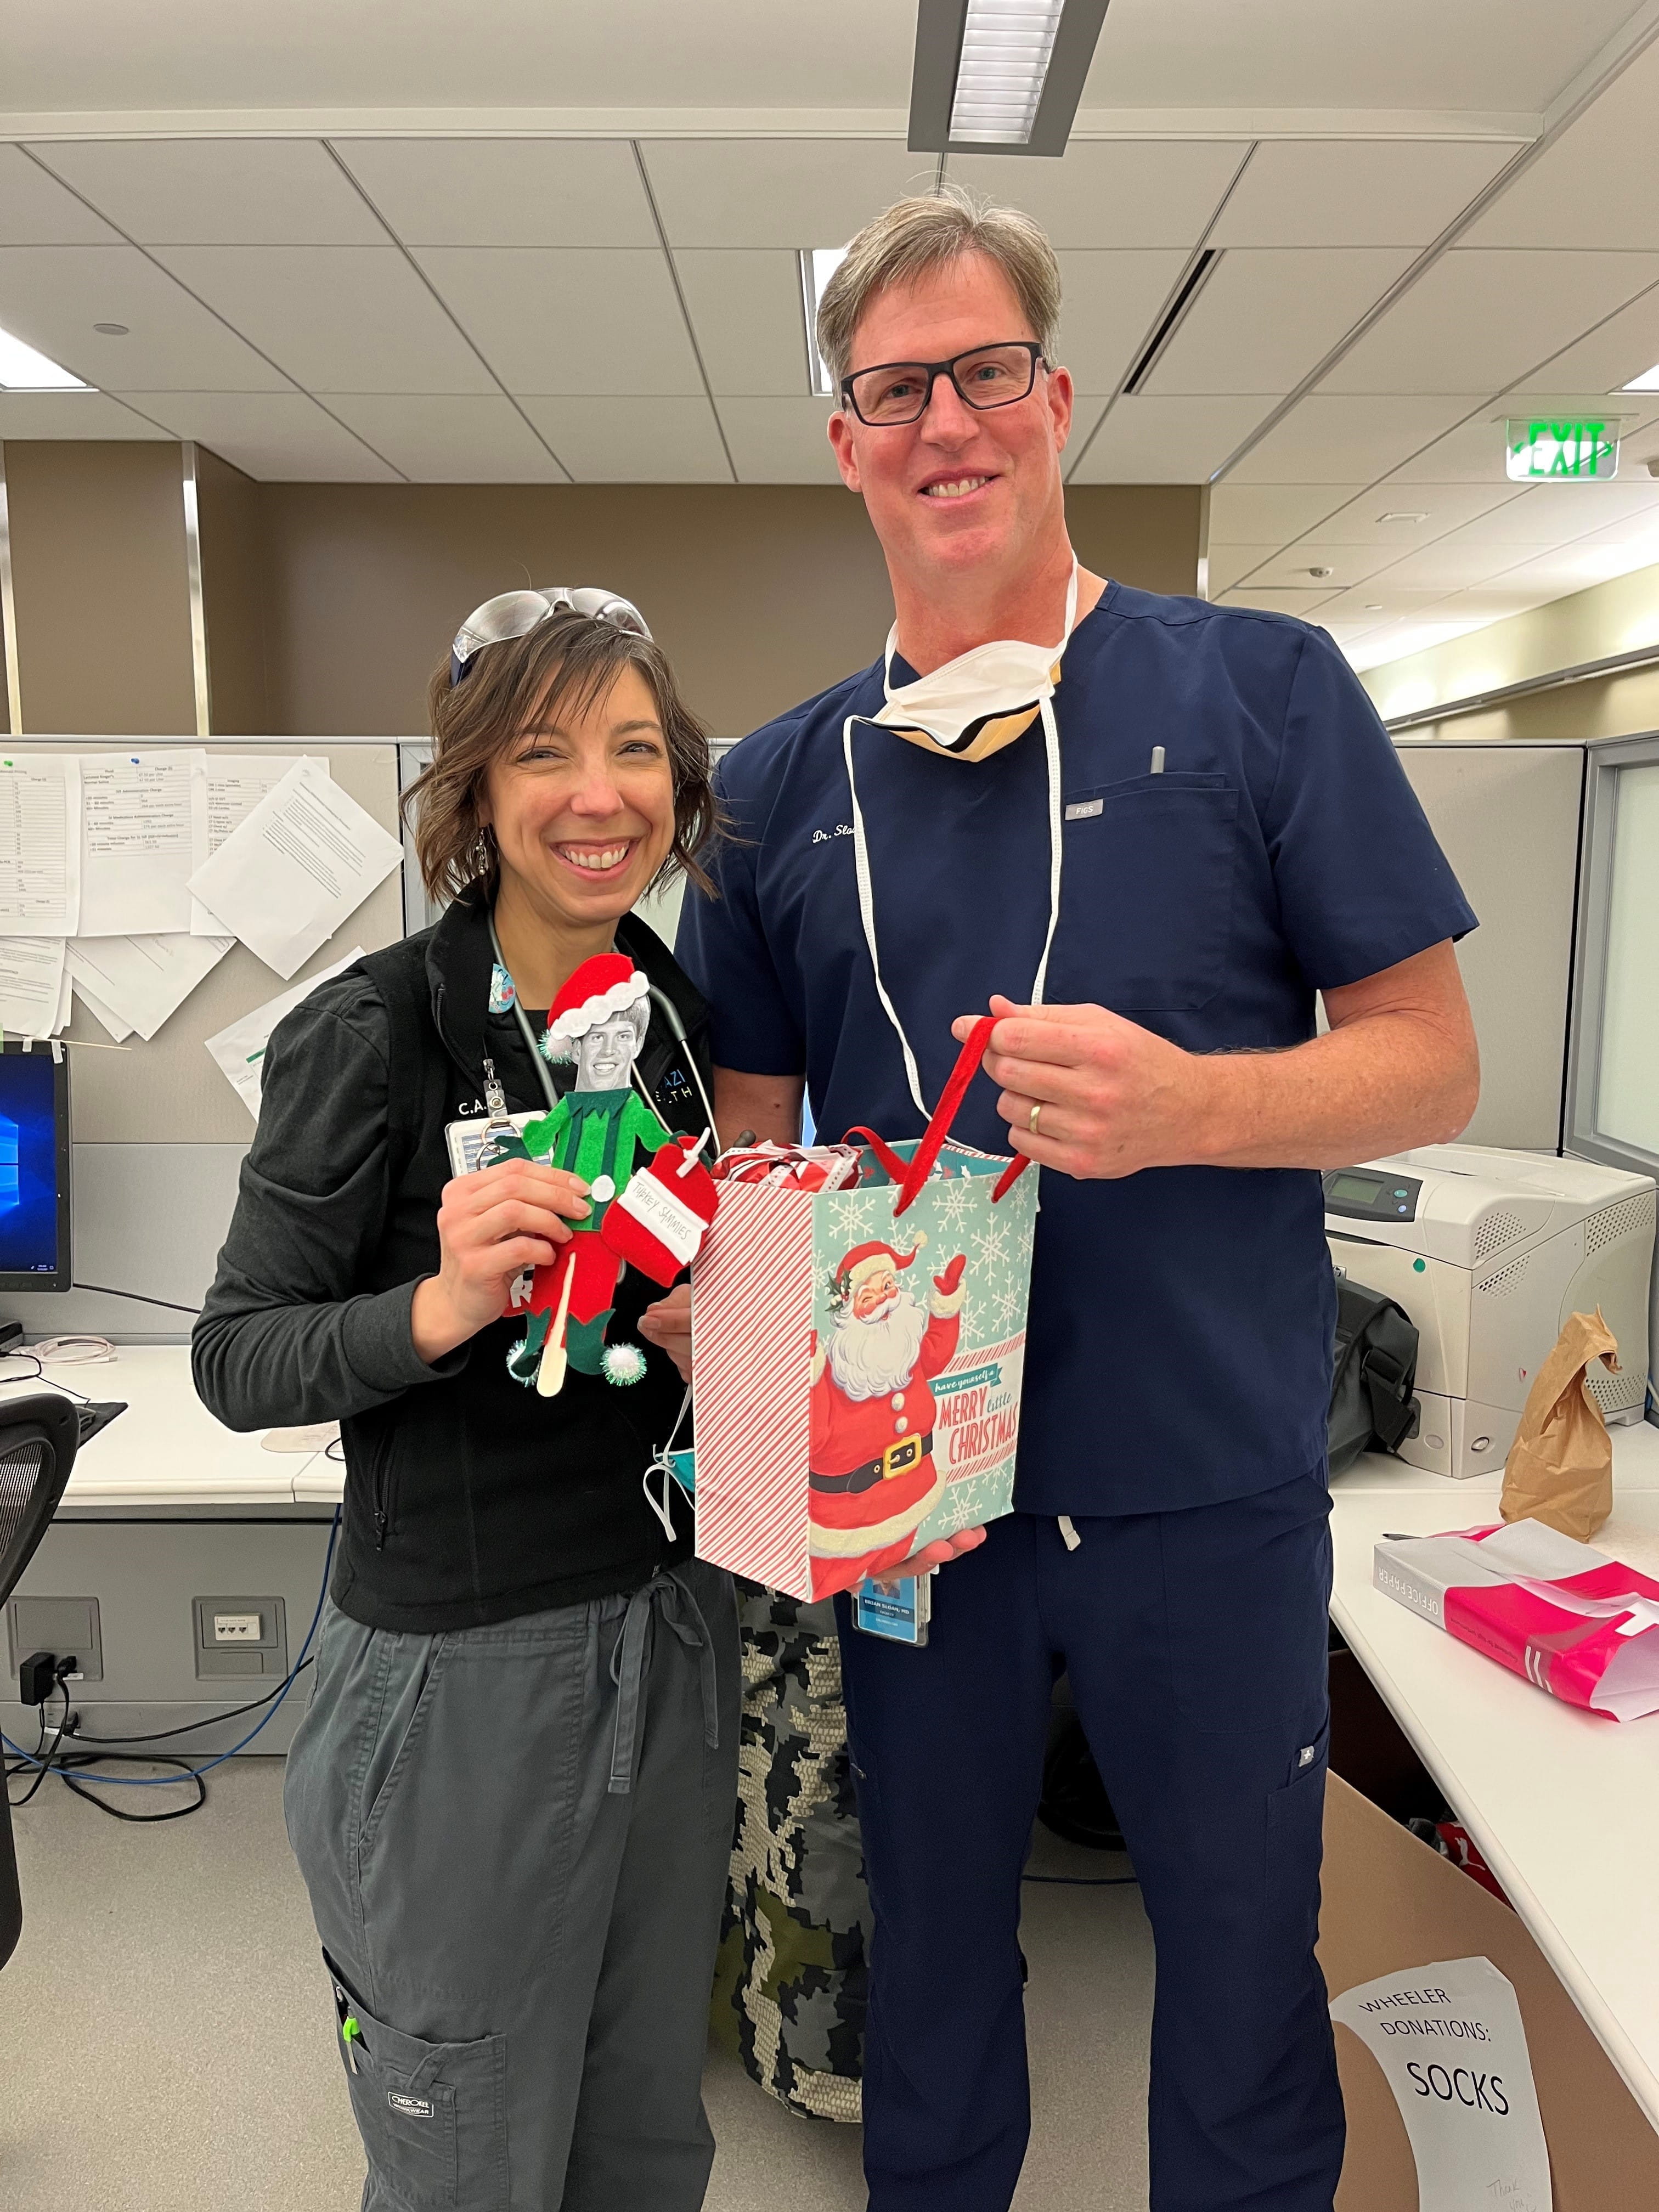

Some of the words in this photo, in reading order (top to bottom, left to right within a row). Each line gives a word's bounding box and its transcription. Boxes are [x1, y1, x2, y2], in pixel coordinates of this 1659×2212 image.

[1528, 423, 1605, 475] EXIT
[1076, 805, 1093, 815] FIGS
[812, 830, 832, 843] Dr.
[633, 1182, 660, 1212] TURKEY
[658, 1206, 692, 1240] SAMMIES
[934, 1382, 957, 1392] have
[956, 1370, 988, 1389] yourself
[939, 1386, 988, 1430] MERRY
[987, 1392, 1012, 1413] little
[949, 1401, 1018, 1464] CHRISTMAS
[1379, 1566, 1406, 1595] PAPER
[864, 1599, 881, 1607] BRIAN
[1408, 1585, 1438, 1616] OFFICE
[1358, 1988, 1451, 2012] WHEELER
[1380, 2019, 1491, 2041] DONATIONS:
[1407, 2062, 1509, 2115] SOCKS
[391, 2096, 430, 2108] CHEROKEE
[392, 2102, 429, 2114] WORKWEAR
